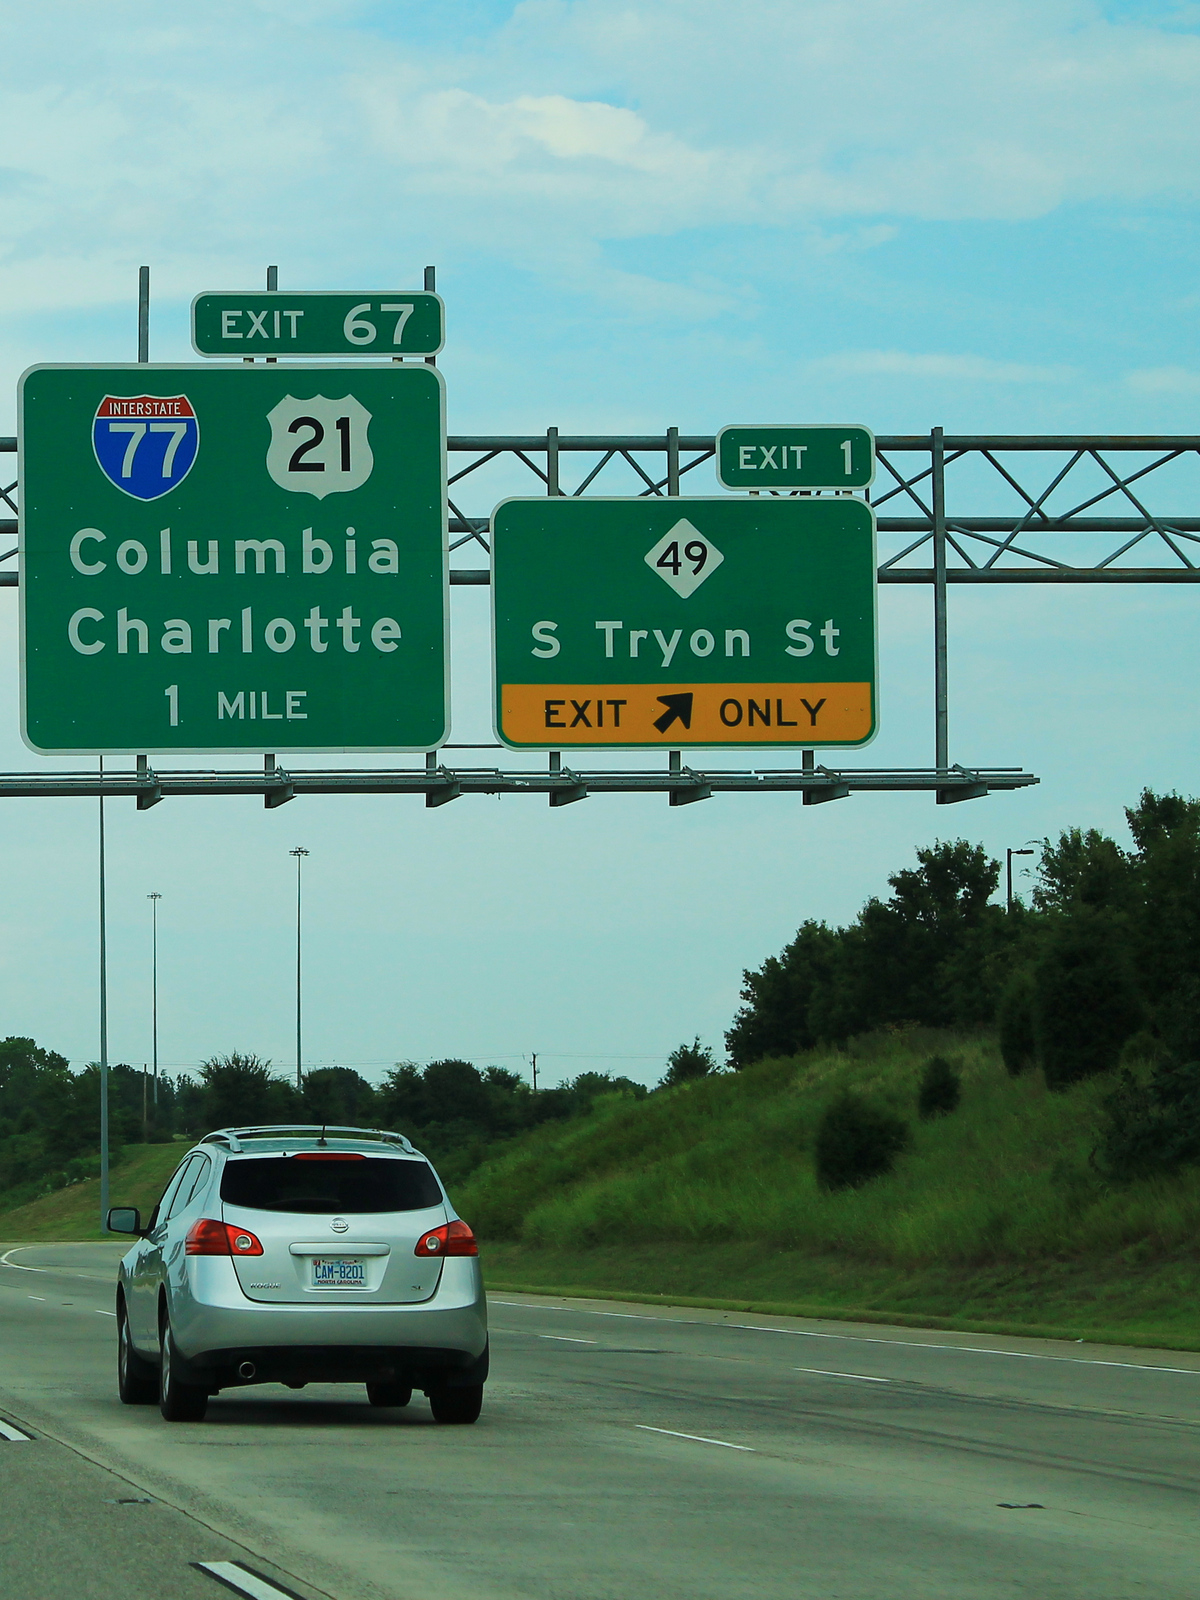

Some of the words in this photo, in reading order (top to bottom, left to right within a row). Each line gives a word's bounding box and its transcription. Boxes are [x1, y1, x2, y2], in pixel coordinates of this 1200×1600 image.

[221, 310, 305, 339] EXIT
[343, 303, 414, 346] 67
[109, 402, 181, 416] INTERSTATE
[108, 422, 188, 478] 77
[287, 416, 351, 473] 21
[739, 445, 808, 470] EXIT
[840, 440, 853, 475] 1
[69, 526, 400, 576] Columbia
[656, 541, 708, 577] 49
[68, 605, 402, 655] Charlotte
[531, 620, 561, 659] S
[595, 620, 750, 668] Tryon
[784, 618, 840, 658] St
[164, 684, 179, 727] 1
[217, 690, 308, 721] MILE
[544, 699, 628, 728] EXIT
[719, 698, 827, 728] ONLY
[315, 1265, 364, 1279] CAM-8201
